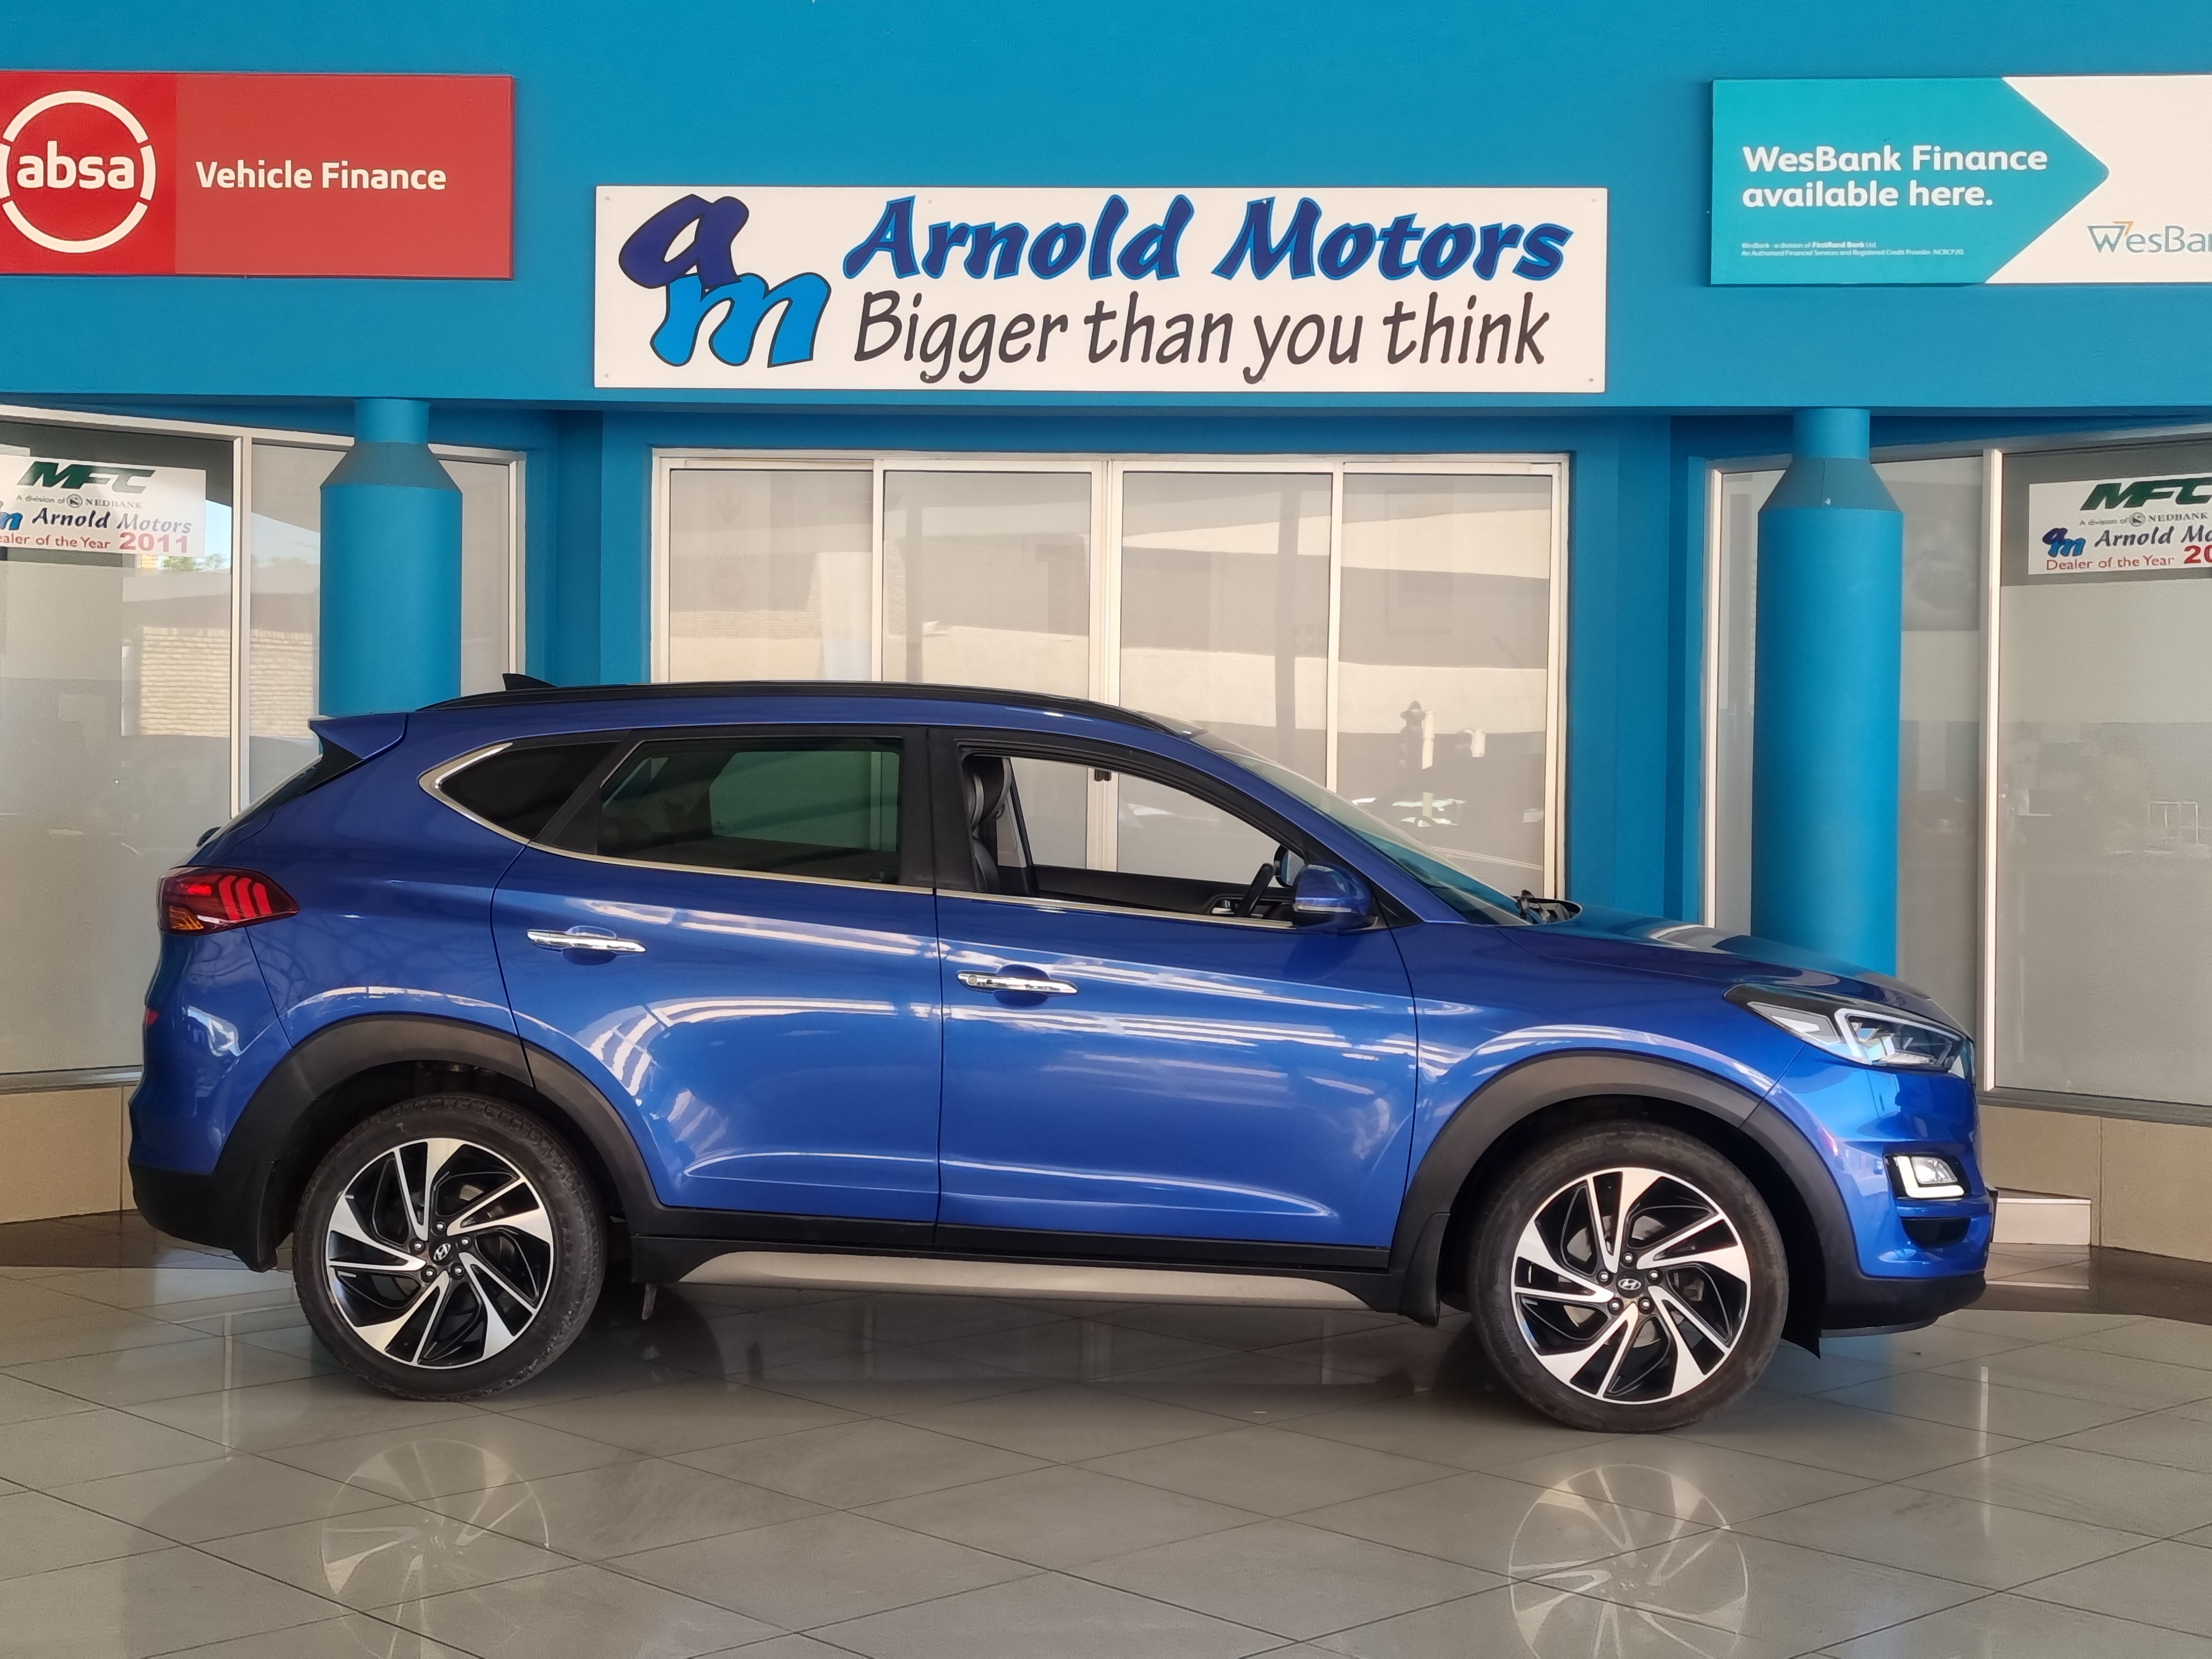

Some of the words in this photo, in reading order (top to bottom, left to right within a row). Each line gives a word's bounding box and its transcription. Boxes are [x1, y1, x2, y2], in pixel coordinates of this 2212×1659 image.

[16, 140, 135, 190] absa
[1742, 144, 1902, 172] WesBank
[1912, 145, 2047, 171] Finance
[195, 160, 313, 189] Vehicle
[322, 161, 447, 191] Finance
[1742, 180, 1899, 207] available
[1909, 179, 1994, 206] here.
[843, 194, 1194, 280] Arnold
[1211, 194, 1574, 281] Motors
[2087, 225, 2212, 253] WesBa
[854, 290, 1068, 384] Bigger
[1084, 290, 1234, 364] than
[1243, 315, 1363, 385] you
[1383, 291, 1550, 364] think
[16, 461, 156, 494] MFC
[85, 498, 142, 509] NEDBANK
[2148, 511, 2208, 522] NEDBANK
[32, 507, 111, 528] Arnold
[116, 513, 192, 534] Motors
[36, 534, 51, 545] of
[55, 535, 78, 548] the
[80, 537, 111, 549] Year
[119, 532, 188, 554] 2011
[2095, 526, 2175, 548] Arnold
[2046, 558, 2093, 571] Dealer
[2098, 556, 2113, 568] of
[2117, 556, 2140, 567] the
[2142, 555, 2174, 566] Year
